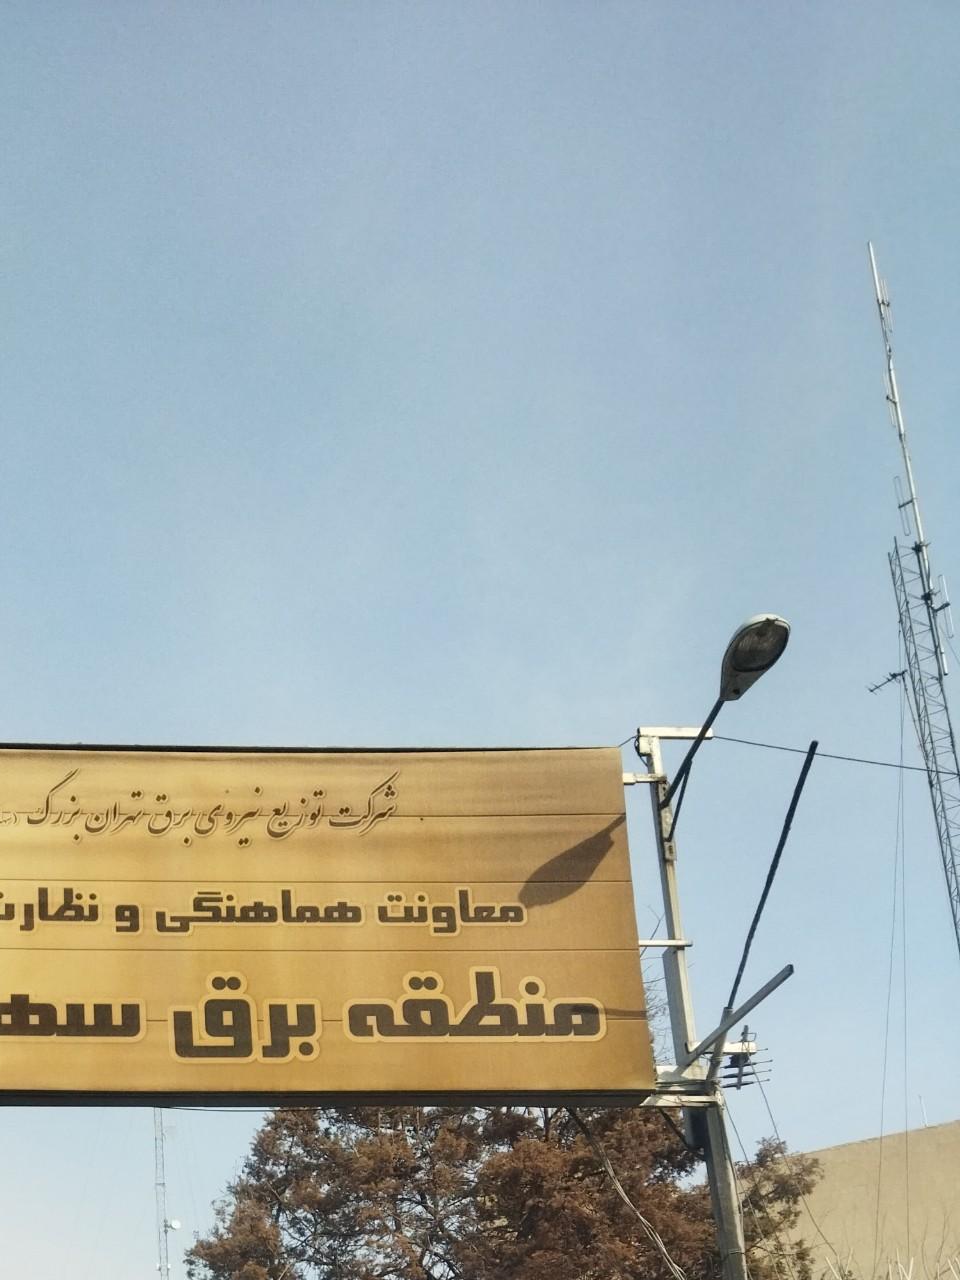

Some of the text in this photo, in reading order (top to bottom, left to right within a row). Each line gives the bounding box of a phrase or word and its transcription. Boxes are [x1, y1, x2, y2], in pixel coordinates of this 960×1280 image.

[26, 767, 82, 842] بزرگ
[85, 790, 144, 836] تهران
[147, 793, 193, 845] برق
[193, 786, 265, 846] نیروی
[266, 788, 327, 839] توزیع
[327, 769, 401, 835] شرکت
[114, 902, 140, 933] و
[156, 889, 362, 934] هماهنگی
[378, 889, 525, 935] معاونت
[173, 976, 317, 1058] برق
[347, 965, 602, 1038] منطقه
